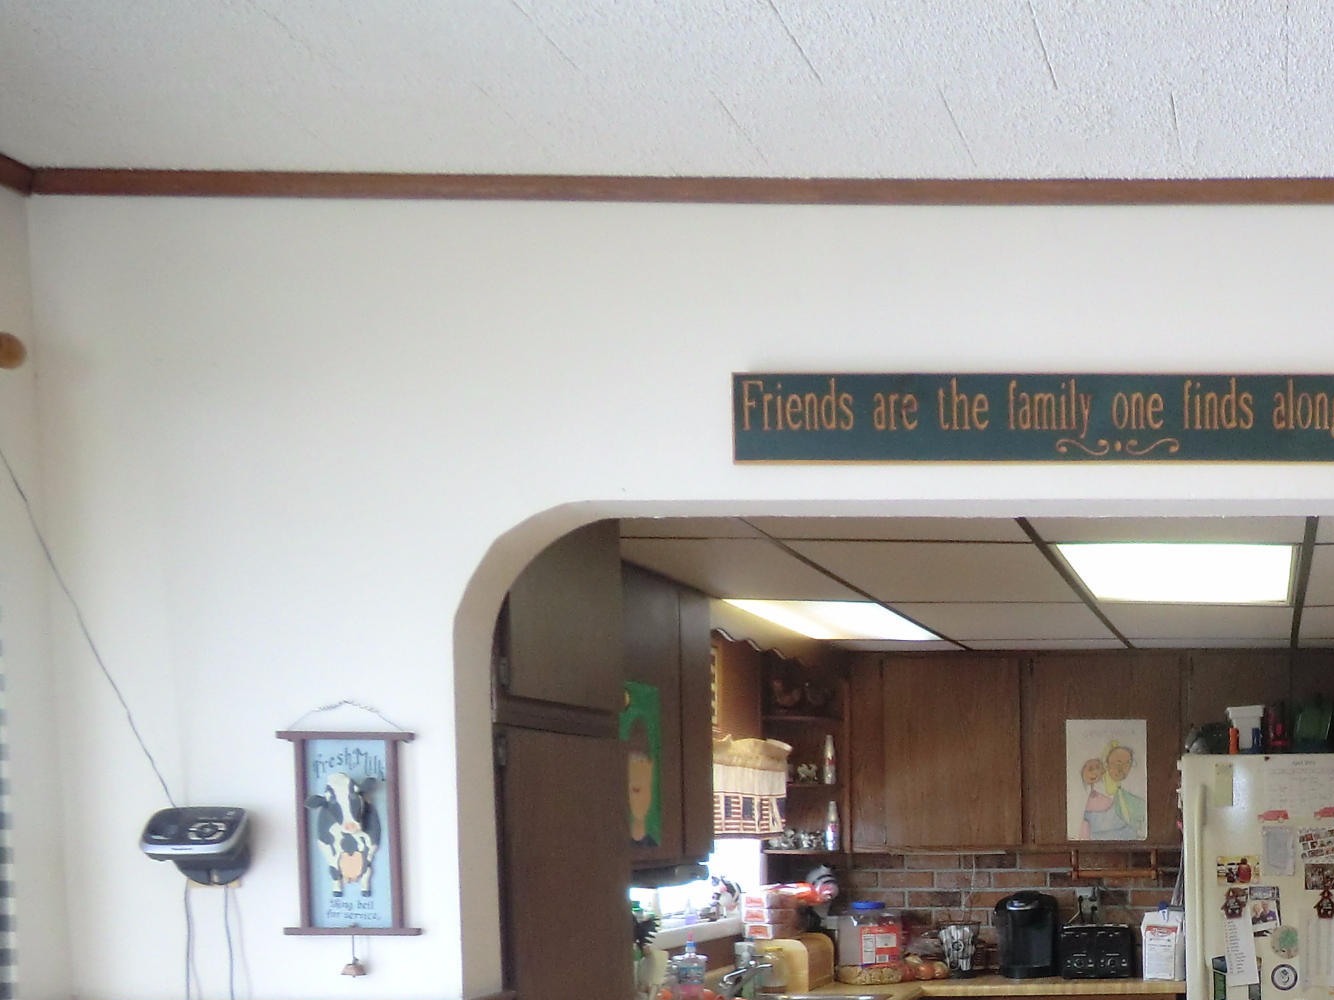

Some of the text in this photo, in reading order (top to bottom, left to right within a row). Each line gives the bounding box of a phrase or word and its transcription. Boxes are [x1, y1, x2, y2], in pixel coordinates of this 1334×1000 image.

[740, 378, 855, 431] Friends
[872, 391, 919, 431] are
[937, 377, 990, 431] the
[1008, 378, 1092, 439] family
[1111, 391, 1165, 431] one
[1183, 376, 1255, 430] finds
